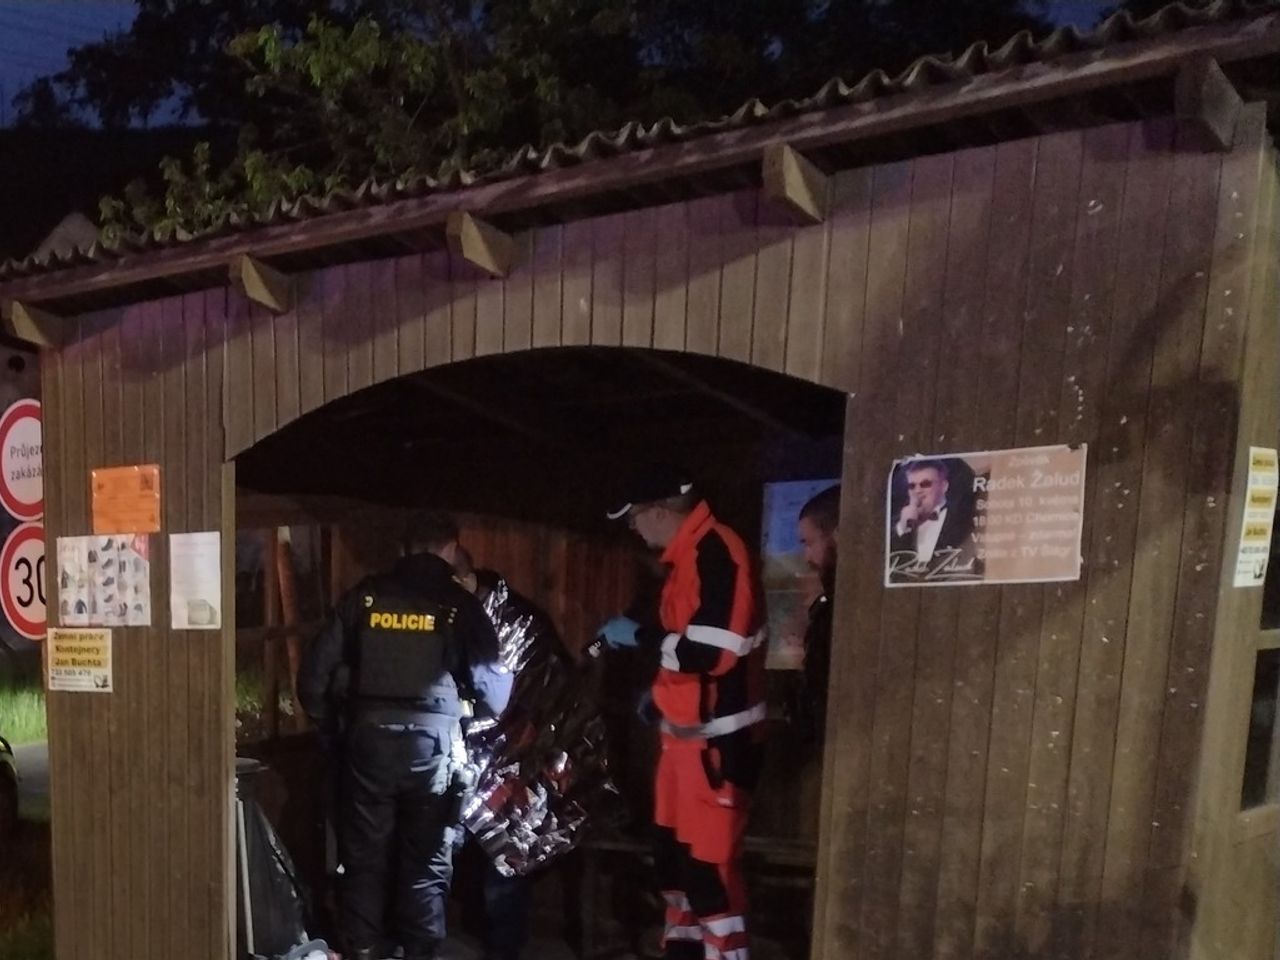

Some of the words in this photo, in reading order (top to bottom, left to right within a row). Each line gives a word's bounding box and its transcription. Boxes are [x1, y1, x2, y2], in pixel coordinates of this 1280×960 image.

[10, 443, 42, 459] Průjez
[973, 475, 1025, 492] Radek
[370, 612, 435, 631] POLICIE
